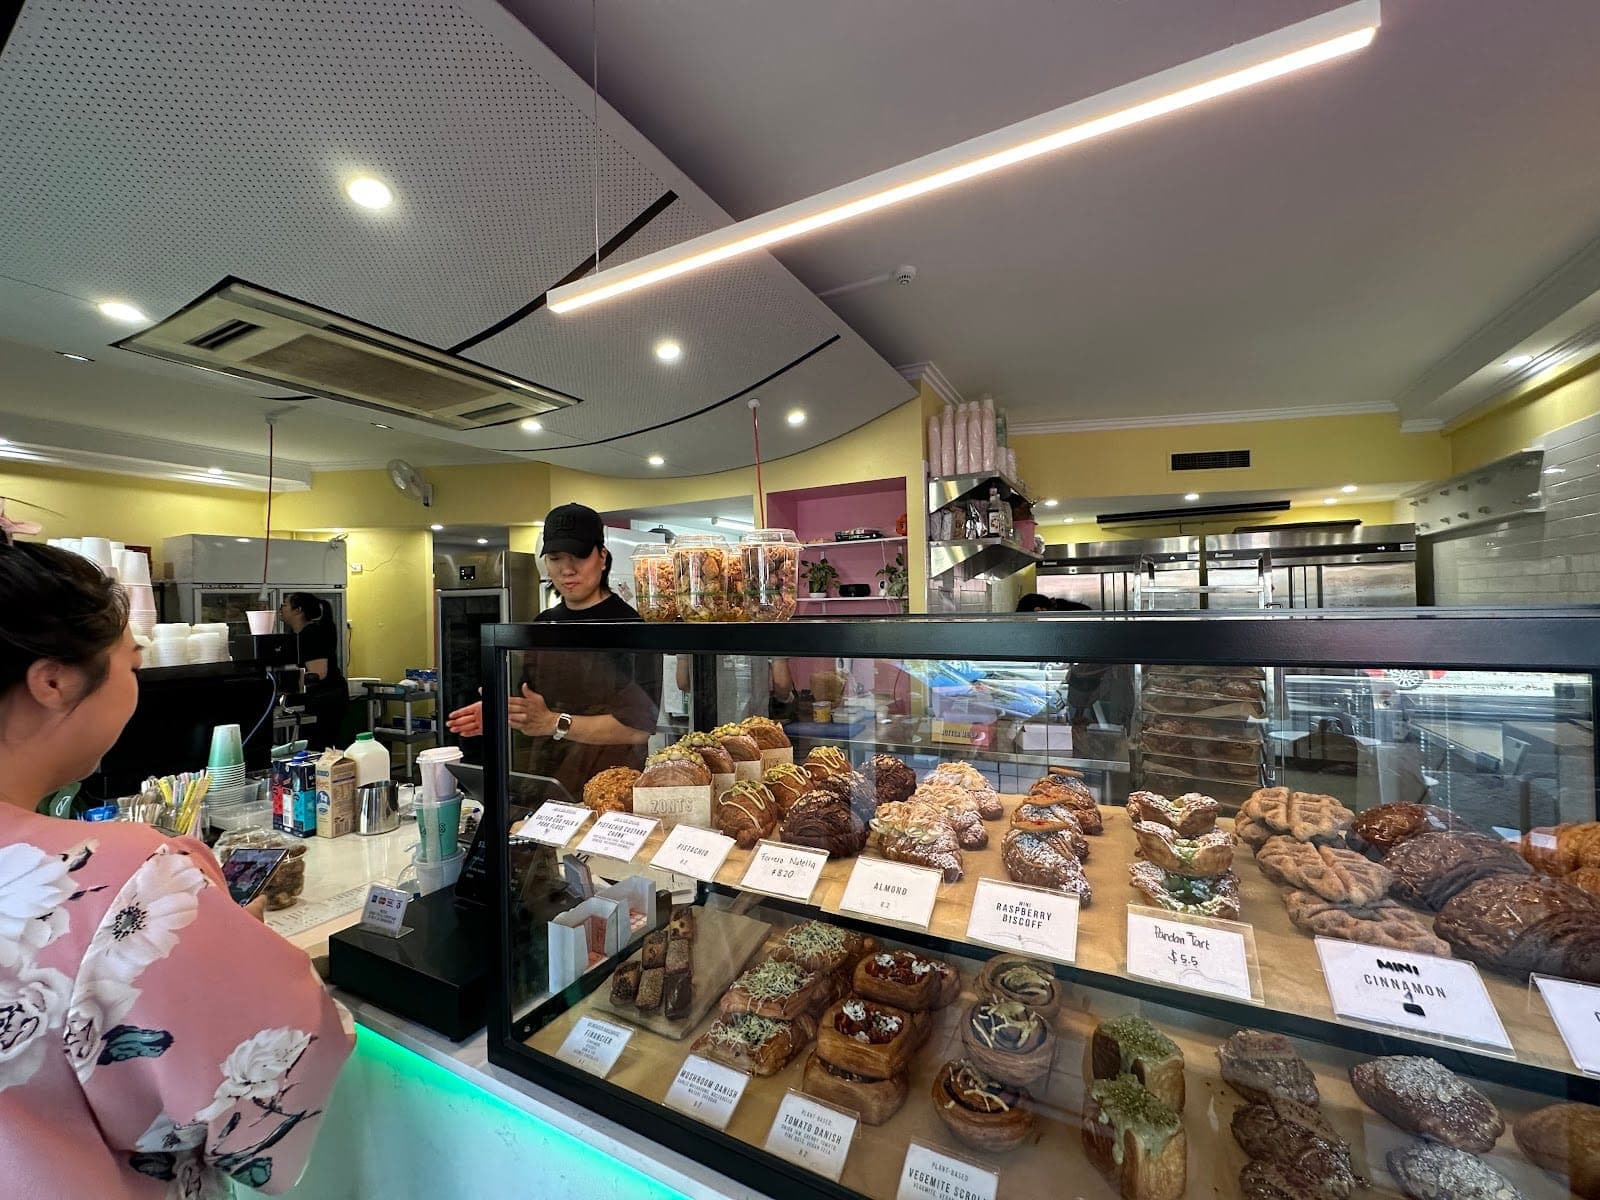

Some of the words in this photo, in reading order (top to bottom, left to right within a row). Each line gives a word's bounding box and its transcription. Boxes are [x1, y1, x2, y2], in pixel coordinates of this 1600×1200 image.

[598, 821, 624, 831] PISTACHIO
[623, 826, 647, 836] CUSTARD
[676, 842, 710, 857] PISTACHIO
[789, 856, 816, 869] Nutella
[873, 882, 908, 896] ALMOND
[996, 902, 1052, 922] RASPBERRY
[1002, 914, 1043, 930] BISCOFF
[1154, 925, 1185, 944] Pandan
[1186, 931, 1210, 950] Tart
[1376, 958, 1420, 976] MINI
[1363, 973, 1447, 999] CINNAMON
[680, 1070, 714, 1089] MUSHROOM
[714, 1083, 739, 1098] DANISH
[784, 1114, 813, 1132] TOMATO
[814, 1126, 842, 1145] DANISH
[909, 1167, 951, 1194] VEGEMITE
